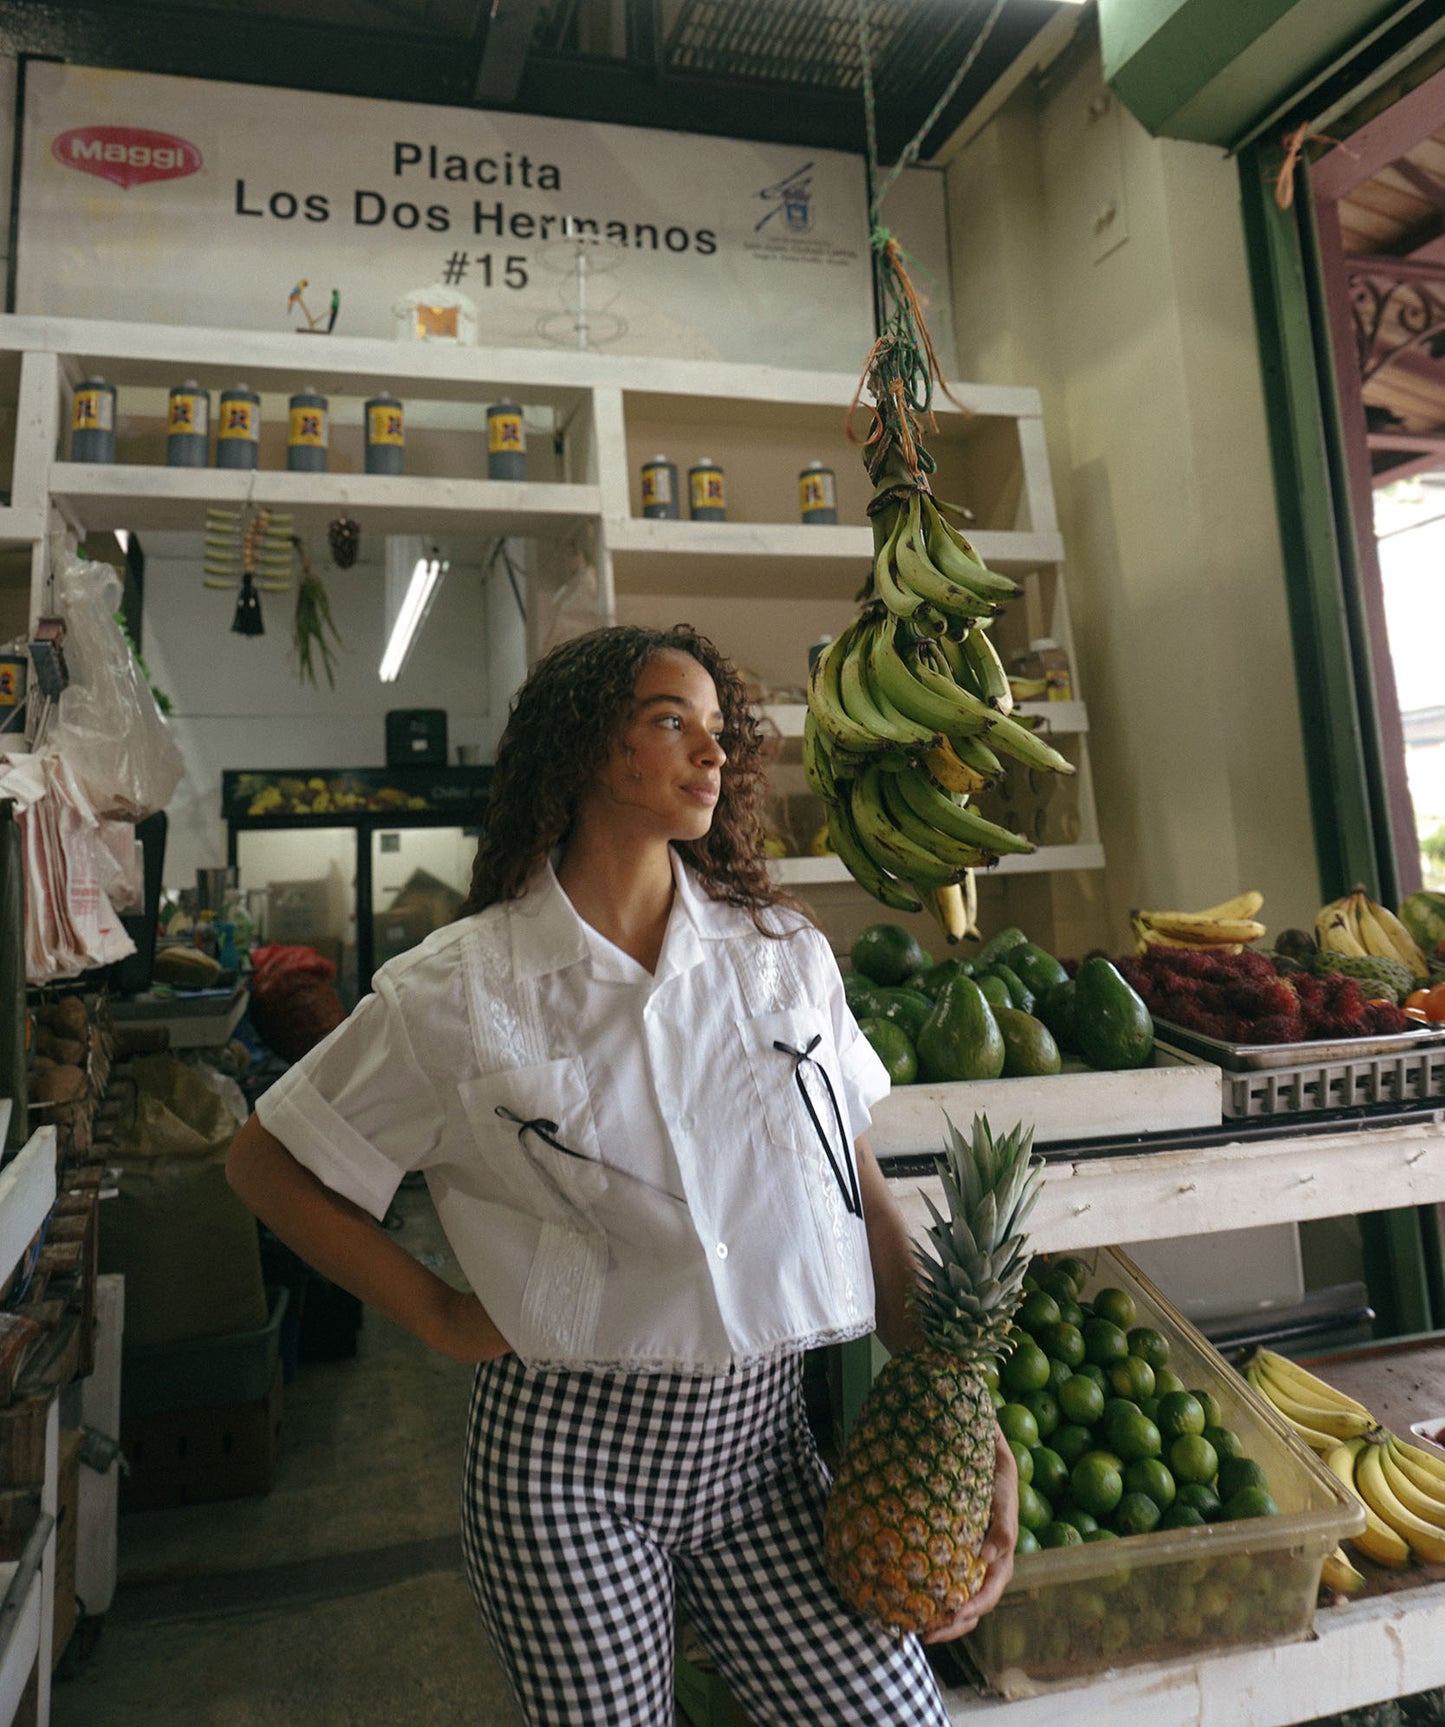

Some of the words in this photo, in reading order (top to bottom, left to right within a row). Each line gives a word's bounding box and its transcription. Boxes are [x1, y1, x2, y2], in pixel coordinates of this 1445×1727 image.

[394, 142, 561, 191] Placita
[236, 179, 330, 223] Los
[354, 190, 452, 232] Dos
[473, 200, 718, 255] Hermanos
[443, 251, 529, 289] #15
